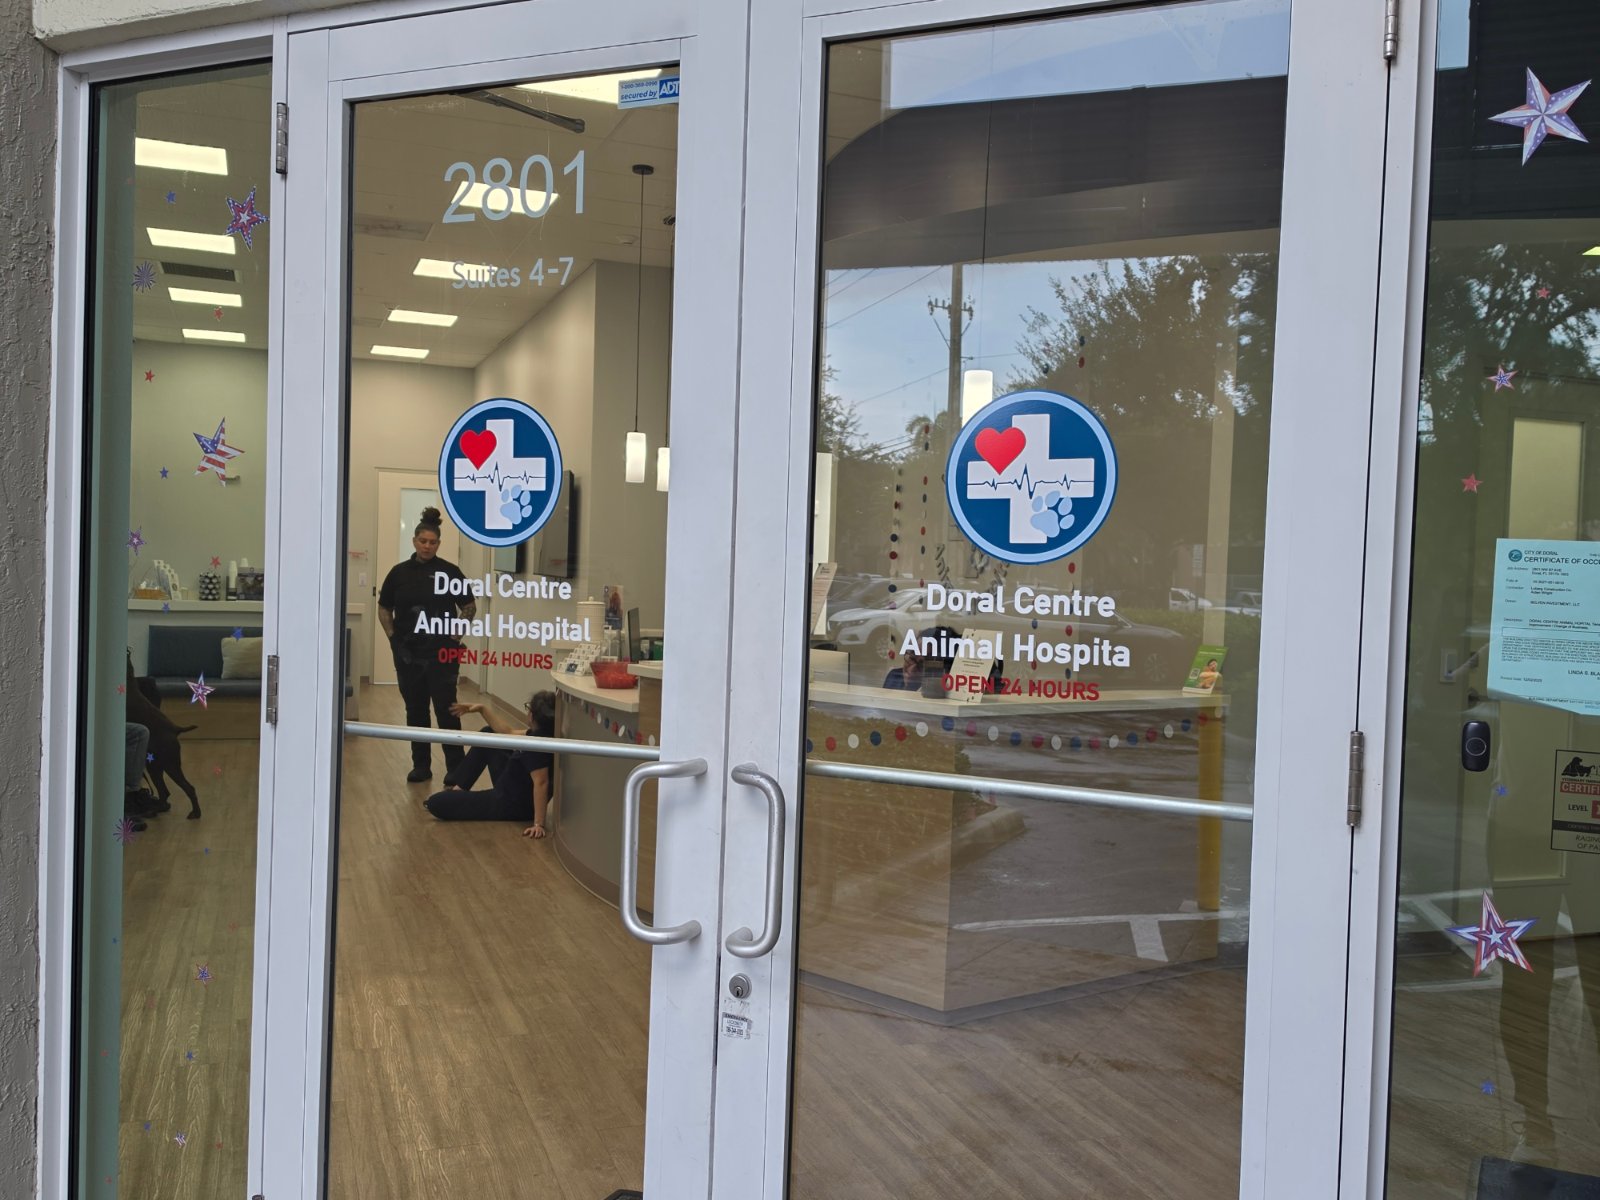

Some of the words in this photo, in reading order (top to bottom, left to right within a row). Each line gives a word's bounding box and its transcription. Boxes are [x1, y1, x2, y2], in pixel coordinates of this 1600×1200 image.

[621, 91, 648, 100] secured
[649, 90, 657, 98] by
[660, 81, 679, 95] ADT
[442, 150, 585, 223] 2801
[452, 261, 521, 289] Suites
[529, 257, 574, 286] 4-7
[1524, 556, 1570, 564] CERTIFICATE
[1571, 557, 1581, 565] OF
[434, 571, 492, 597] Doral
[498, 574, 572, 600] Centre
[927, 583, 1005, 613] Doral
[1014, 586, 1116, 617] Centre
[414, 610, 492, 638] Animal
[498, 613, 591, 646] Hospital
[438, 648, 477, 665] OPEN
[481, 651, 497, 666] 24
[502, 652, 553, 669] HOURS
[899, 628, 1004, 661] Animal
[1013, 633, 1131, 672] Hospita
[941, 674, 995, 695] OPEN
[1000, 677, 1022, 696] 24
[1028, 679, 1101, 701] HOURS
